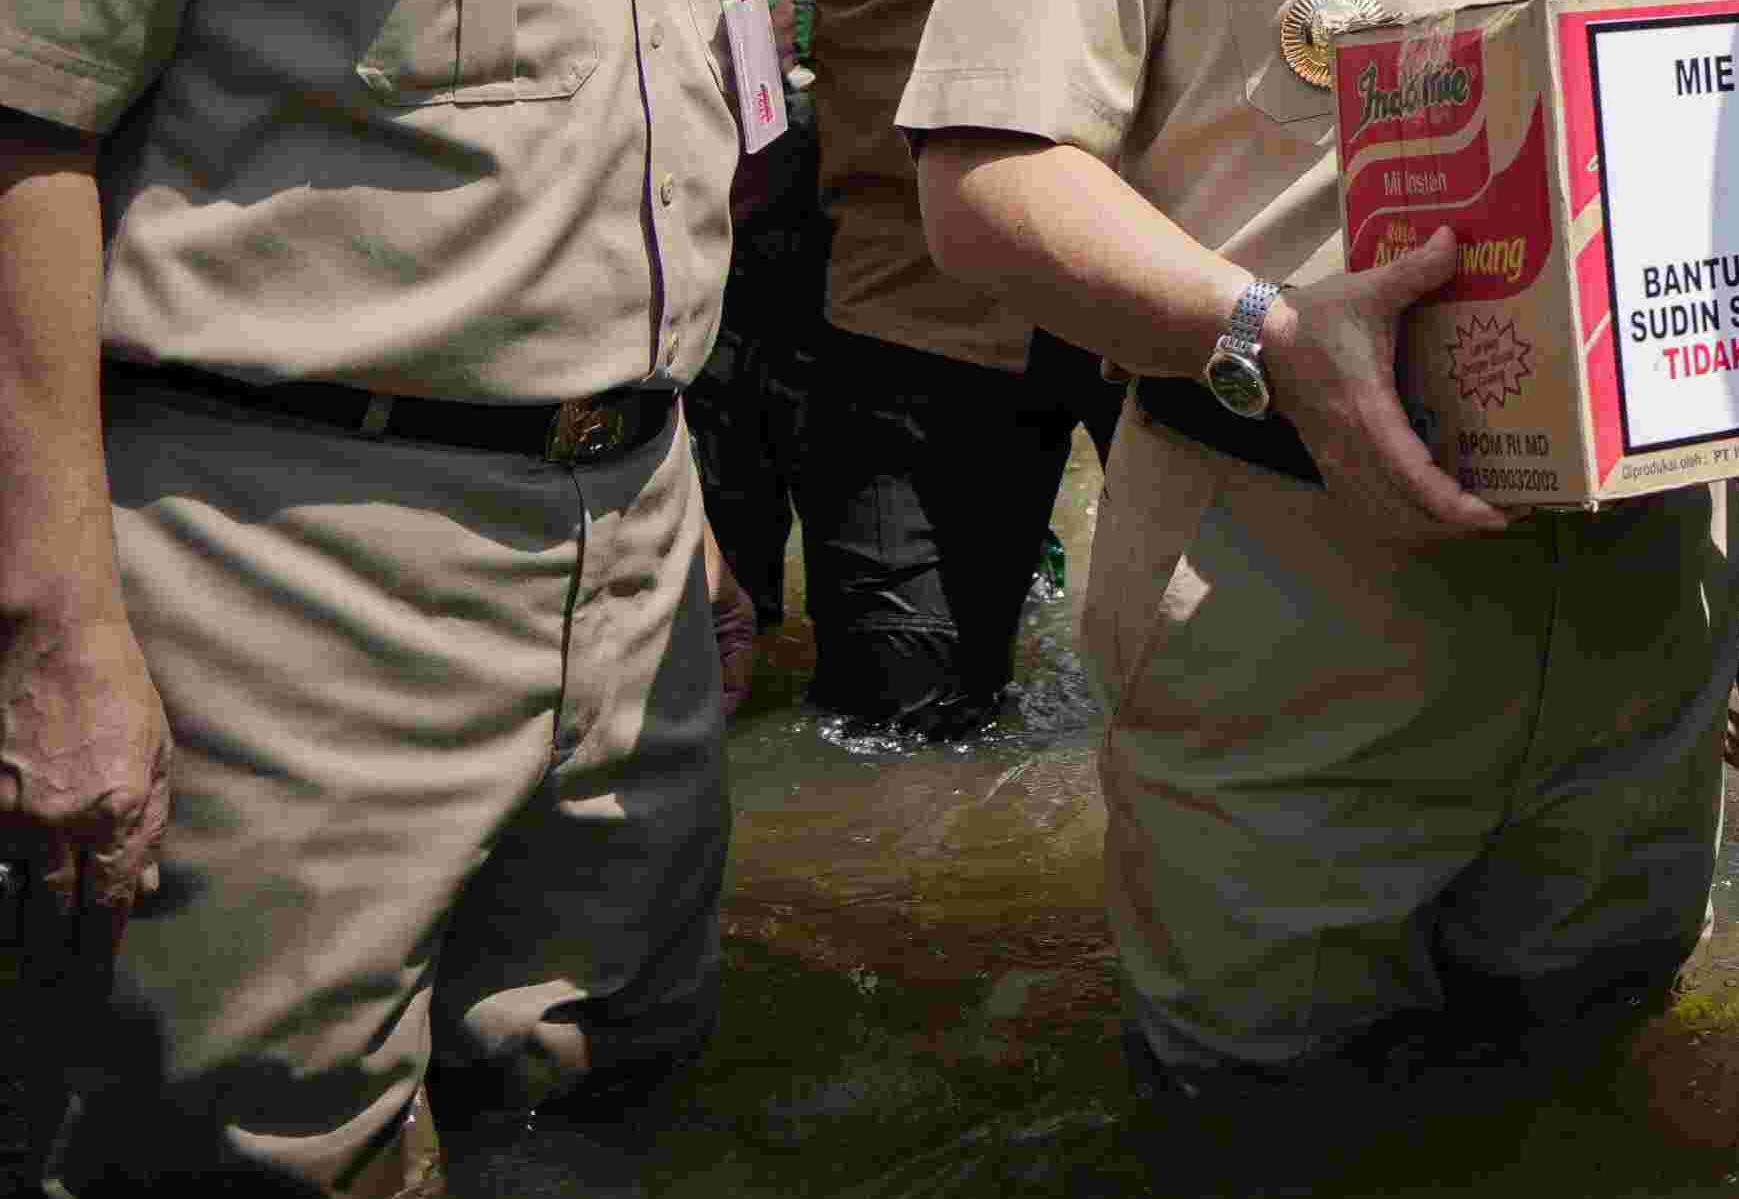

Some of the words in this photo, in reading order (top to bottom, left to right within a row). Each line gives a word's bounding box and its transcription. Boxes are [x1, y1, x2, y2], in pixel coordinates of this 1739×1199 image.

[1675, 54, 1735, 96] MIE
[1384, 171, 1401, 196] Mi
[1405, 171, 1447, 194] Instan
[1631, 299, 1720, 342] SUDIN
[1525, 434, 1549, 457] MD
[1713, 449, 1729, 461] PT
